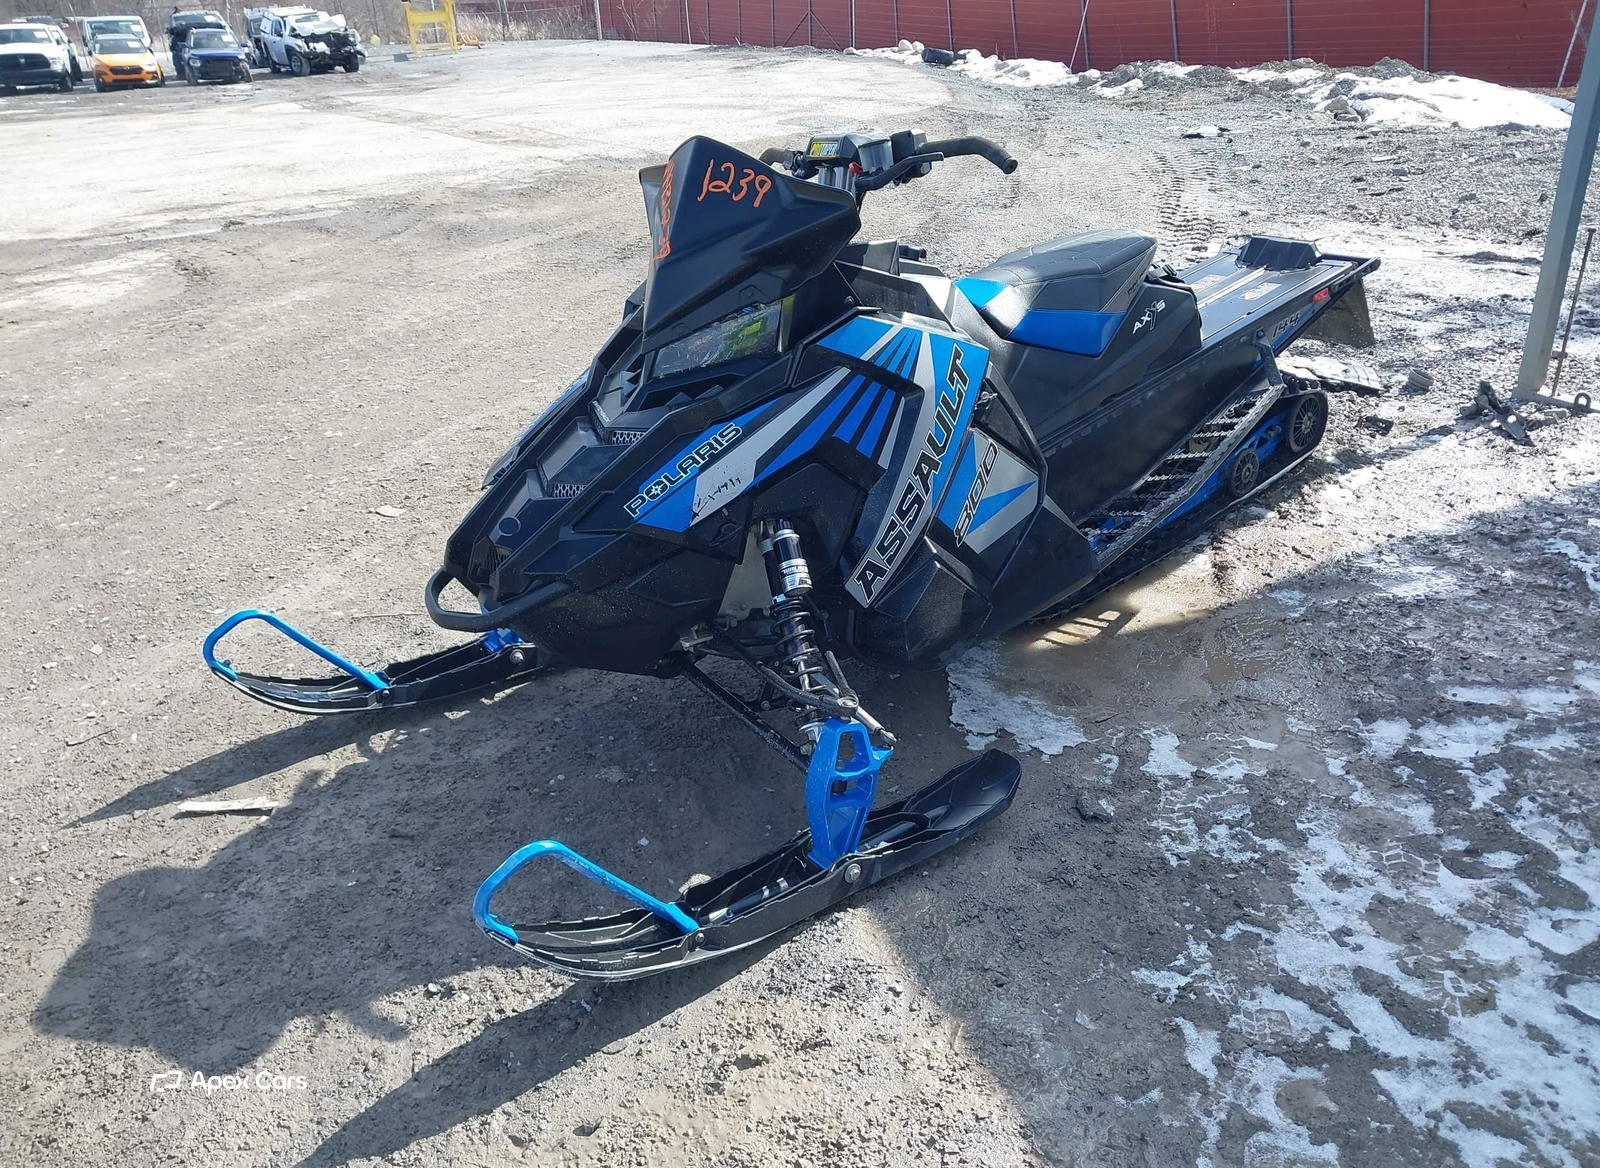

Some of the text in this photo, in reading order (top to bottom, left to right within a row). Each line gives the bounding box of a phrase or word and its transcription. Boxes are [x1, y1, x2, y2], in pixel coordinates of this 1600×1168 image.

[697, 159, 772, 208] 1239
[1272, 310, 1301, 340] 144
[623, 422, 743, 518] POLARIS
[853, 343, 970, 604] ASSAULT
[953, 438, 1001, 548] 800
